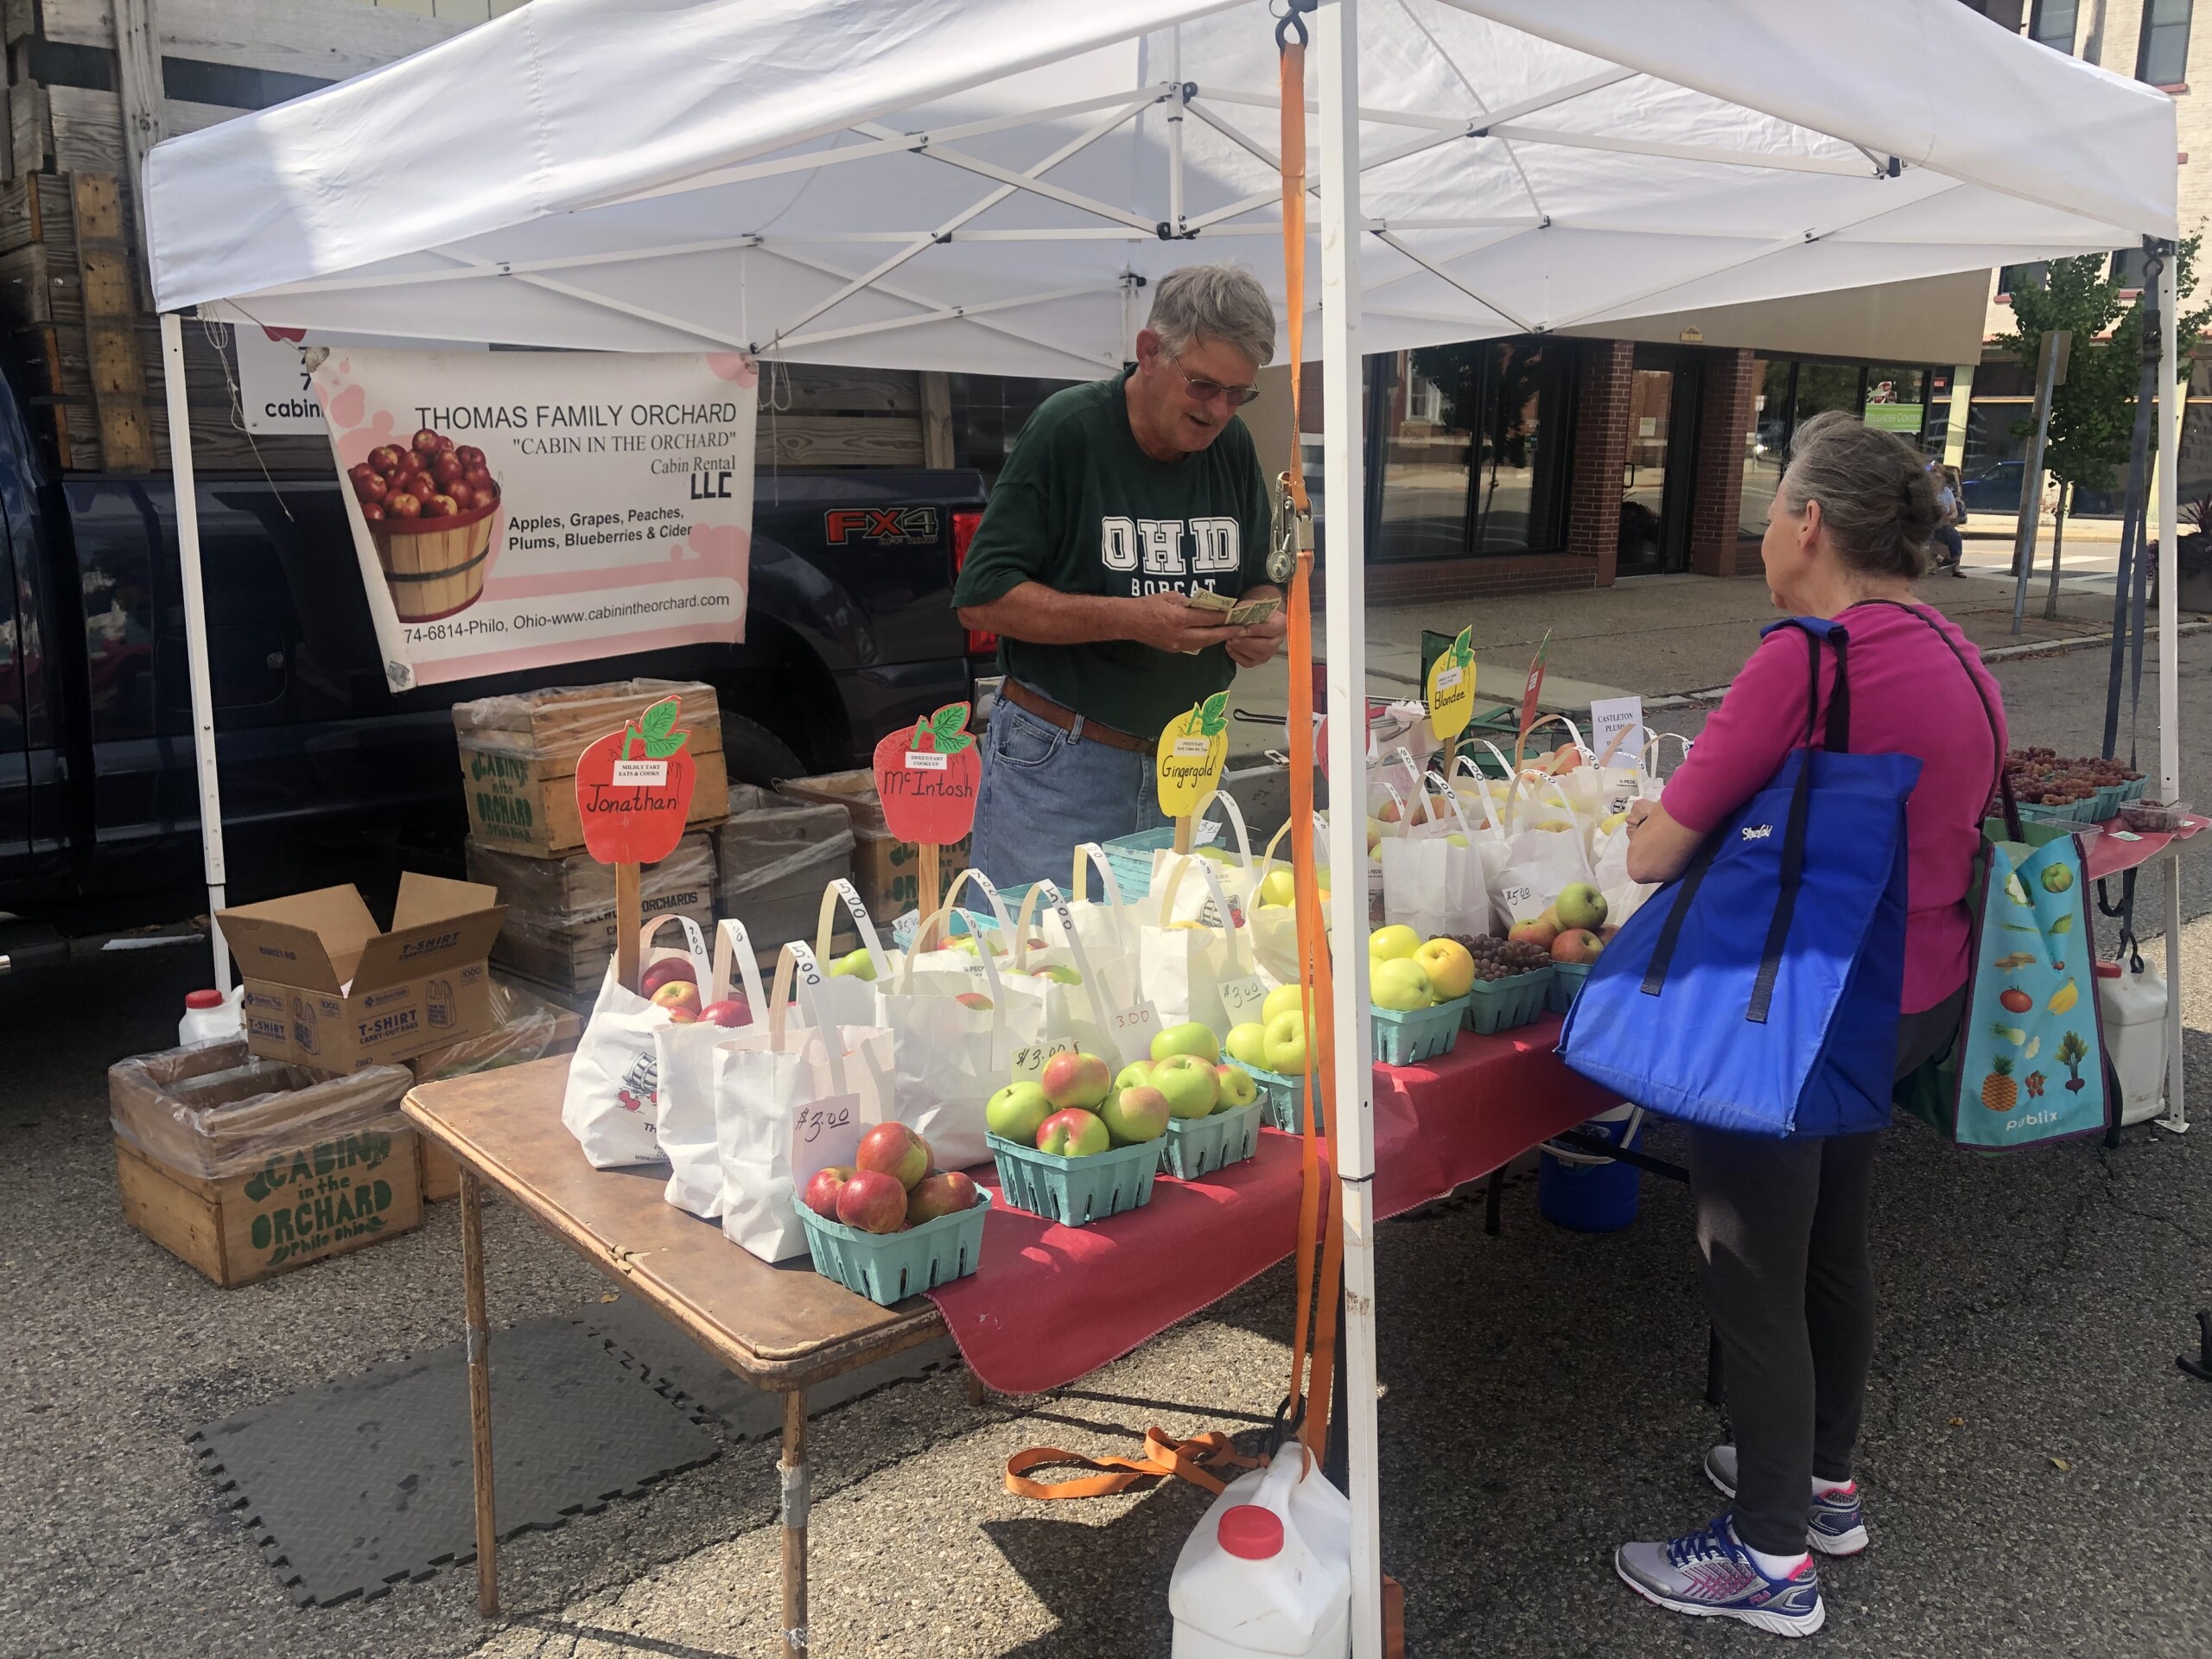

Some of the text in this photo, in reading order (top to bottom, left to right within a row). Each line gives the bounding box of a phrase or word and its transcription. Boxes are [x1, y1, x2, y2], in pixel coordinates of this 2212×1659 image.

[415, 403, 736, 429] THOMAS FAMILY ORCHARD
[513, 432, 736, 454] "CABIN IN THE ORCHARD"
[651, 455, 736, 474] Cabin Rental
[690, 472, 733, 500] LLC
[509, 507, 684, 532] Apples, Grapes, Peaches,
[824, 507, 938, 545] FX4
[509, 524, 693, 550] Plums, Blueberries & Cider
[1131, 578, 1217, 598] BOBCAT
[513, 594, 730, 630] Ohio-www.cabinintheorchard.com
[1434, 684, 1465, 709] Blondee
[1598, 713, 1634, 723] CASTLETON
[1162, 754, 1216, 788] Gingergold
[587, 784, 677, 813] Jonathan
[642, 892, 698, 912] ORCHARDS
[839, 883, 866, 918] 5.00
[403, 931, 461, 954] T-SHIRT
[461, 966, 481, 978] 1000
[791, 944, 820, 984] 5.00
[321, 1000, 339, 1011] 1000
[249, 1018, 285, 1034] T-SHIRT
[359, 1009, 417, 1036] T-SHIRT
[1116, 1010, 1150, 1028] 3.00
[359, 1027, 400, 1045] CARRY-OUT
[795, 1107, 850, 1142] $3.00
[2005, 1110, 2057, 1131] publix
[299, 1175, 350, 1200] in the
[251, 1179, 392, 1249] ORCHARD
[290, 1221, 367, 1257] Philo Ohio
